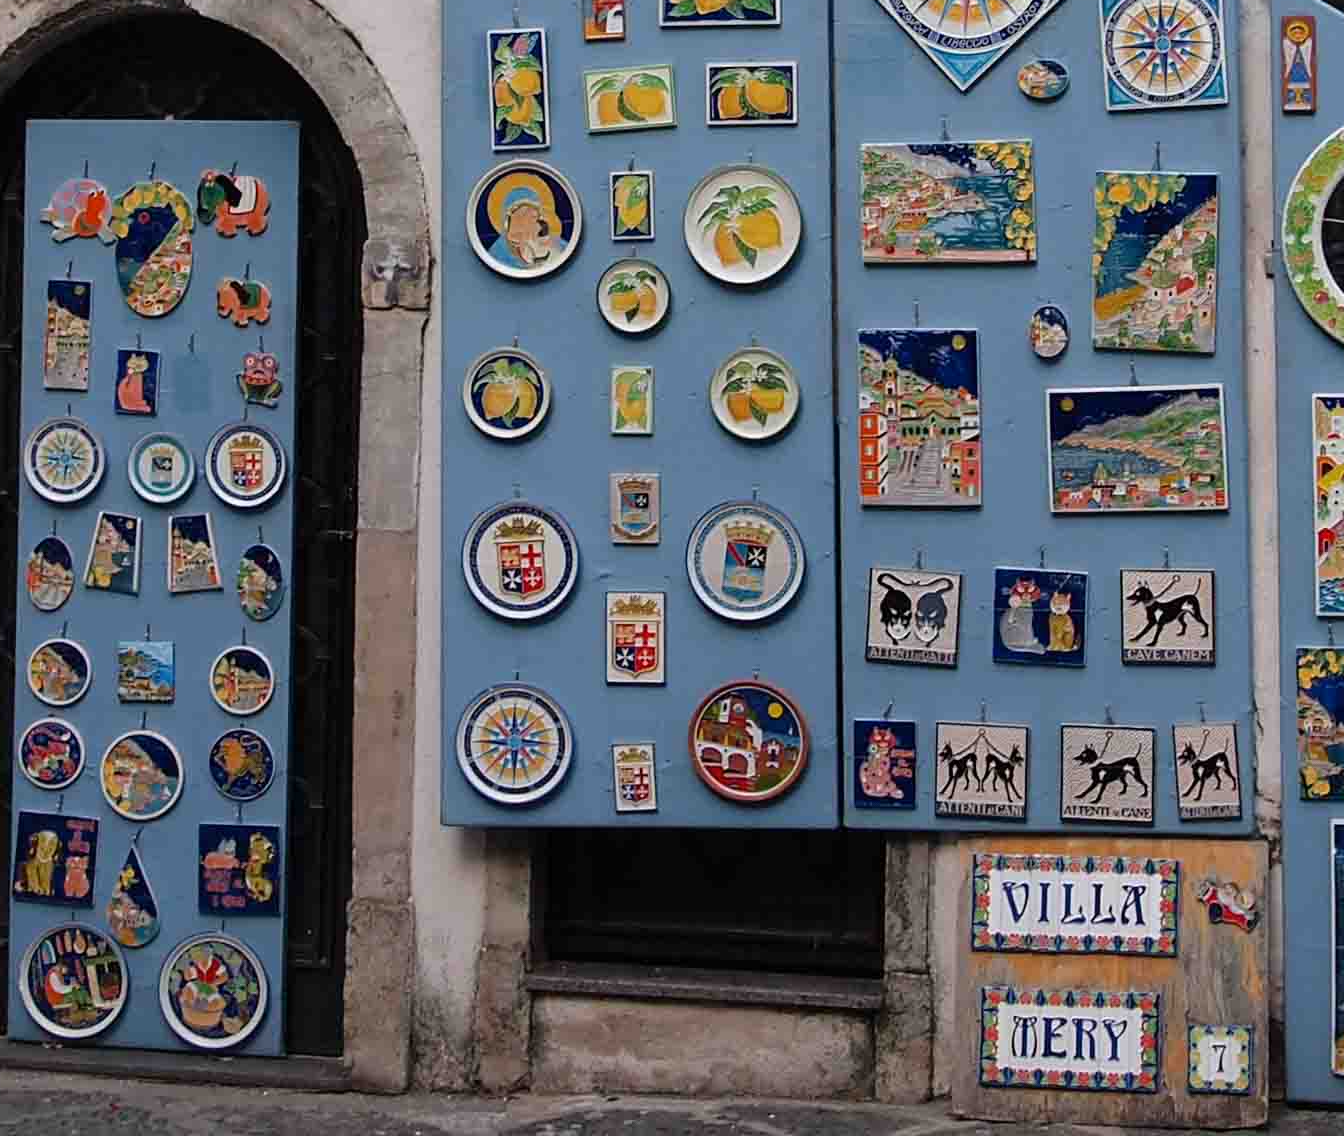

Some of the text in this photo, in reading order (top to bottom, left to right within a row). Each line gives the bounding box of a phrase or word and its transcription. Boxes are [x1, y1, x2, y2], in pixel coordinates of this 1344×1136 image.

[1002, 881, 1147, 925] VILLA
[1012, 1016, 1128, 1061] MERY
[1211, 1044, 1226, 1073] 7
